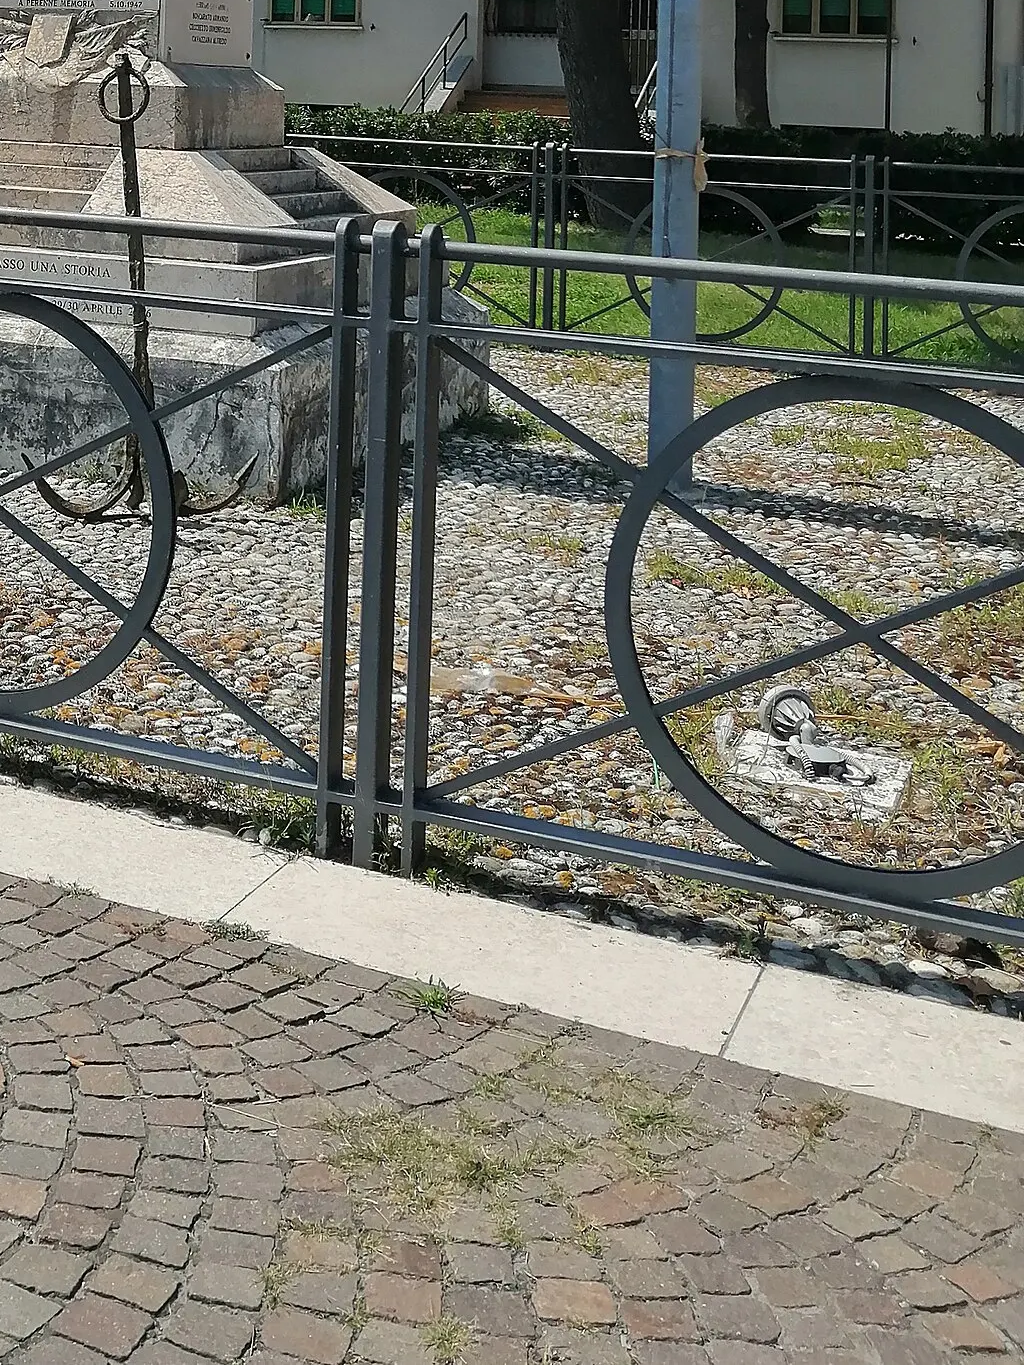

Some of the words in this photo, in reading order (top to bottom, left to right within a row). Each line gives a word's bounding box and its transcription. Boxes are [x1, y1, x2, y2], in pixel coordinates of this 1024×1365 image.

[61, 0, 95, 8] MEMORIA
[31, 260, 57, 273] UNA
[64, 264, 111, 278] STORIA
[83, 303, 123, 316] APRILE
